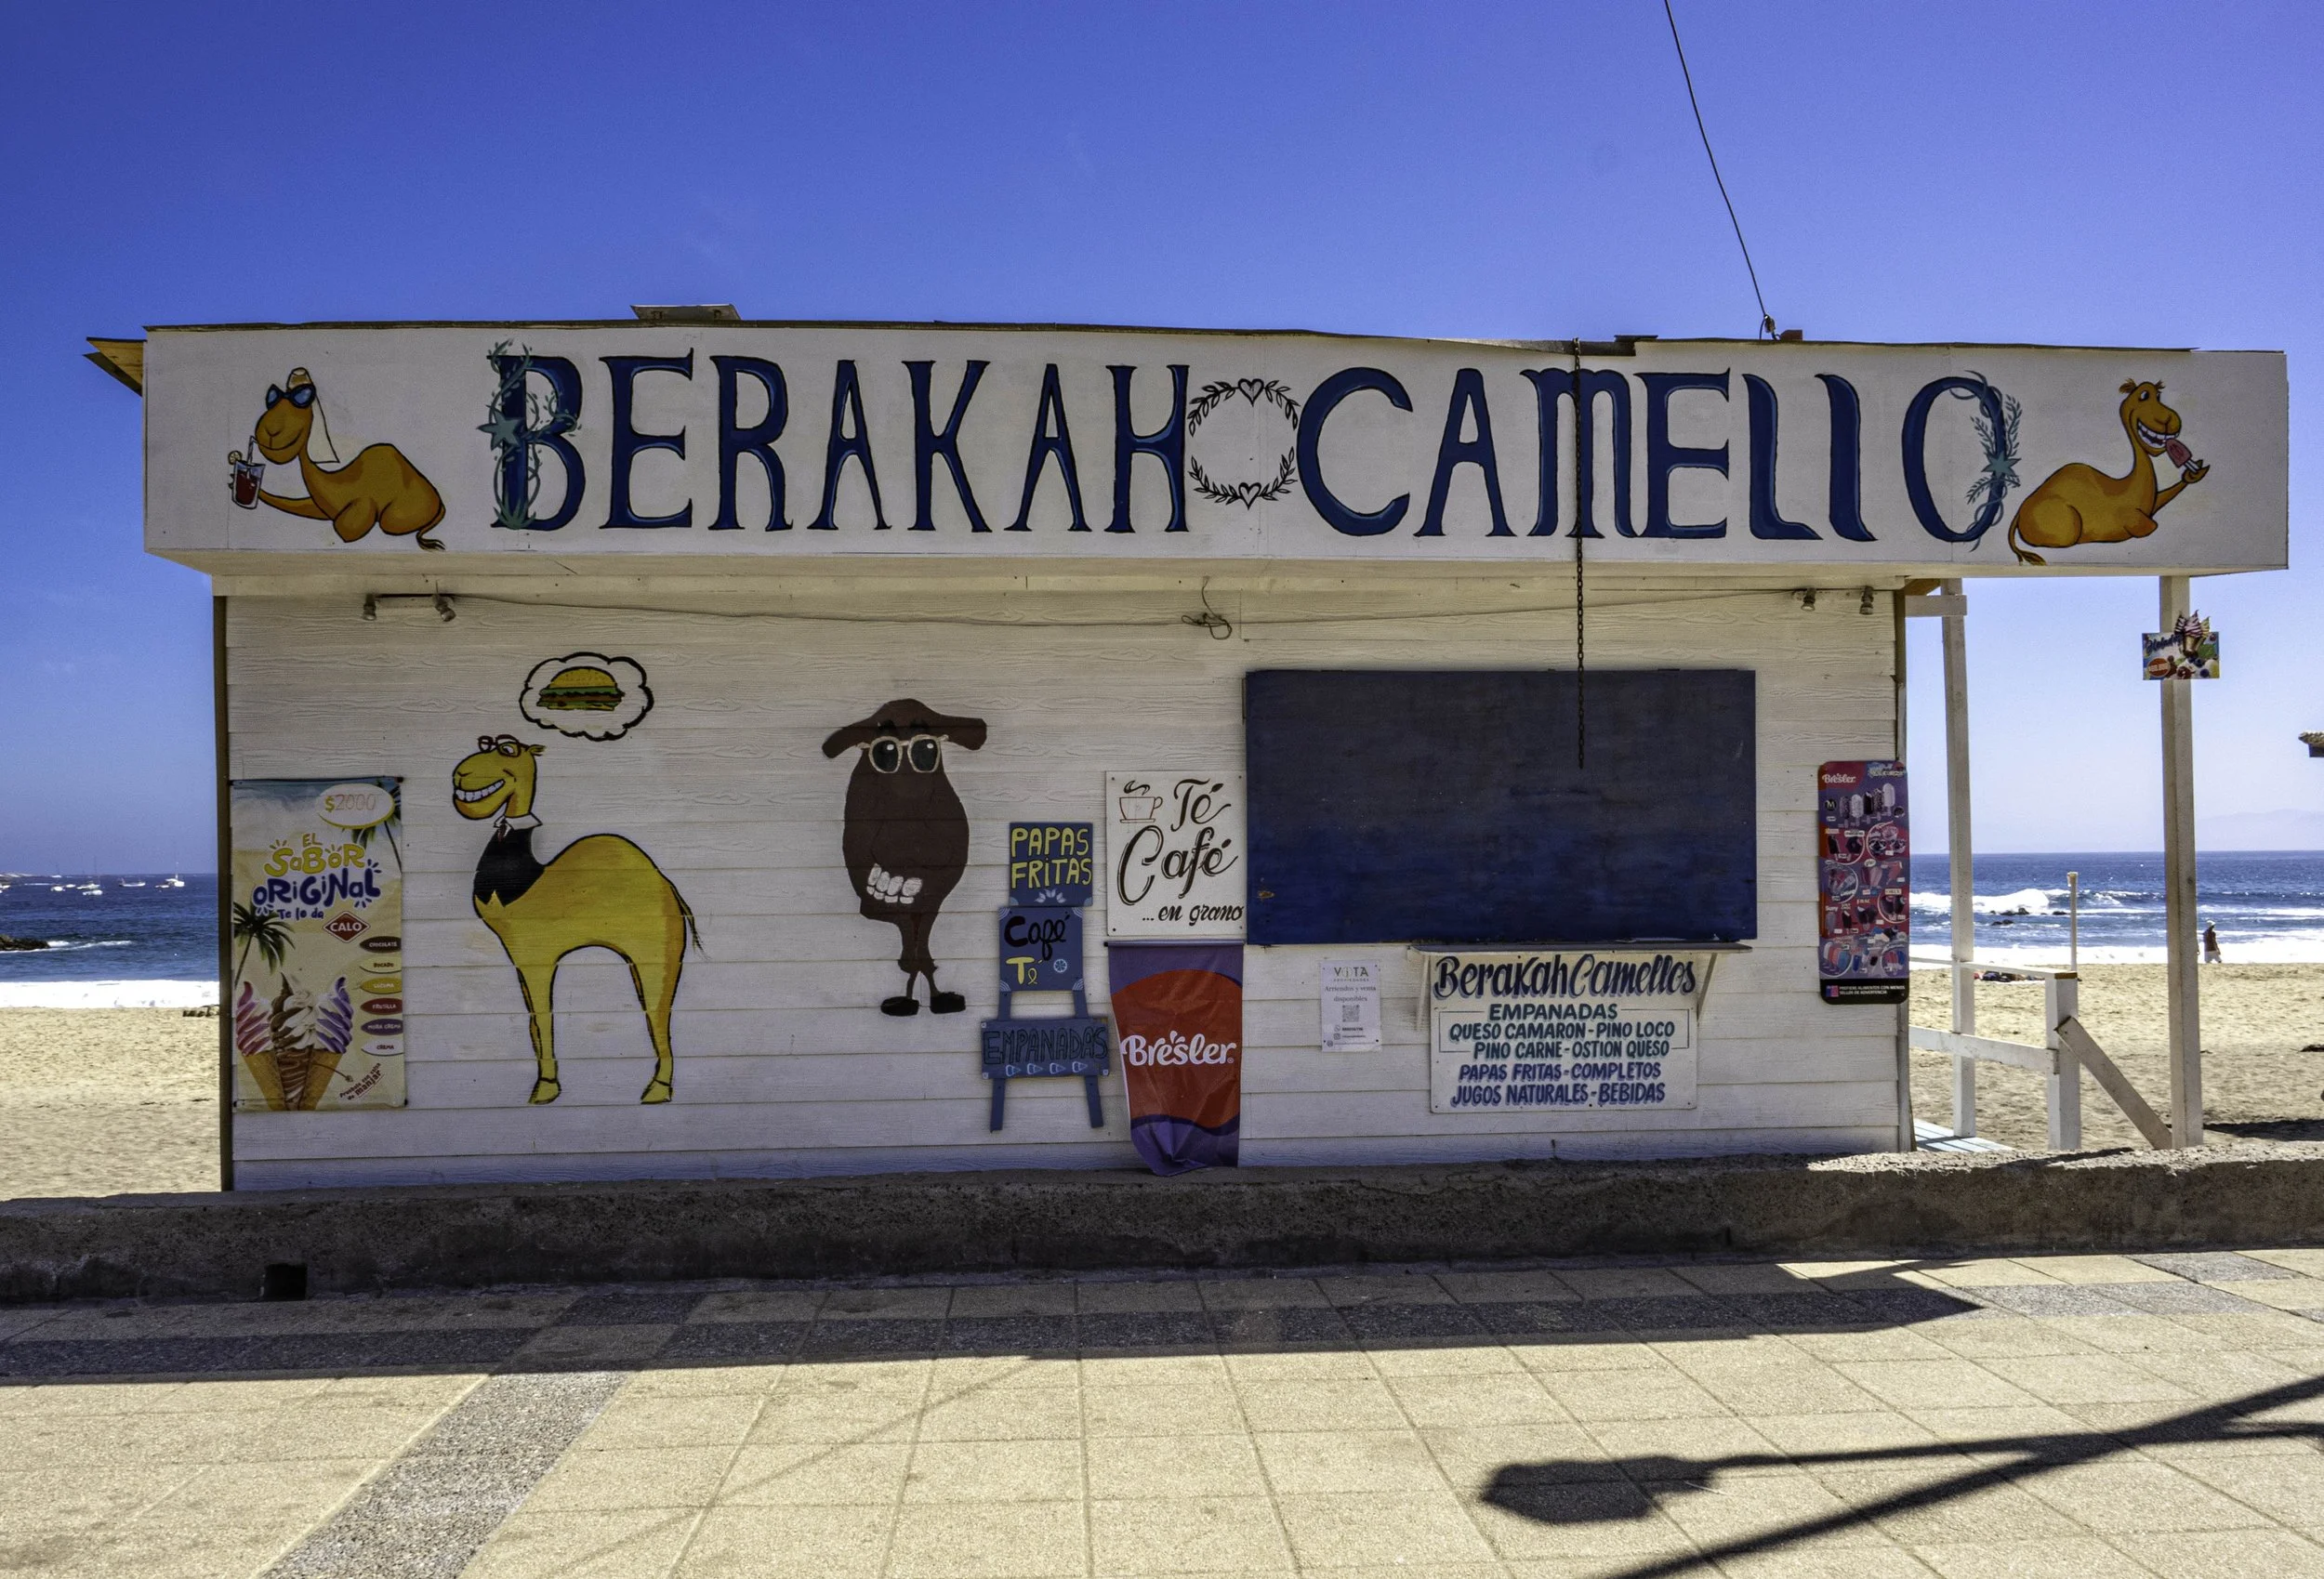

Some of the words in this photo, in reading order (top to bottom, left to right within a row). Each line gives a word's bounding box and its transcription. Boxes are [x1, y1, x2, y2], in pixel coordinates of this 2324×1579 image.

[486, 349, 1190, 533] BERAKAH
[1297, 366, 2005, 543] CAMELLO
[325, 793, 376, 812] $2000
[1170, 779, 1232, 832] Té
[302, 833, 323, 847] EL
[1011, 826, 1089, 858] PAPAS
[1116, 825, 1238, 905] Café
[277, 909, 291, 919] Te
[296, 908, 307, 920] lo
[310, 908, 324, 919] da
[1189, 904, 1244, 927] grano
[330, 922, 362, 932] CALO
[1004, 915, 1071, 961] Café
[1006, 956, 1043, 985] Té
[1568, 954, 1696, 998] Camellos
[1489, 1004, 1618, 1020] EMPANADAS
[1450, 1022, 1501, 1041] QUESO
[1636, 1021, 1674, 1038] LOCO
[983, 1026, 1108, 1065] EMPANADAS
[1473, 1042, 1511, 1059] PINO
[1627, 1040, 1670, 1059] QUESO
[354, 1070, 381, 1096] manjar
[1459, 1064, 1507, 1082] PAPAS
[1451, 1085, 1501, 1108] JUGOS
